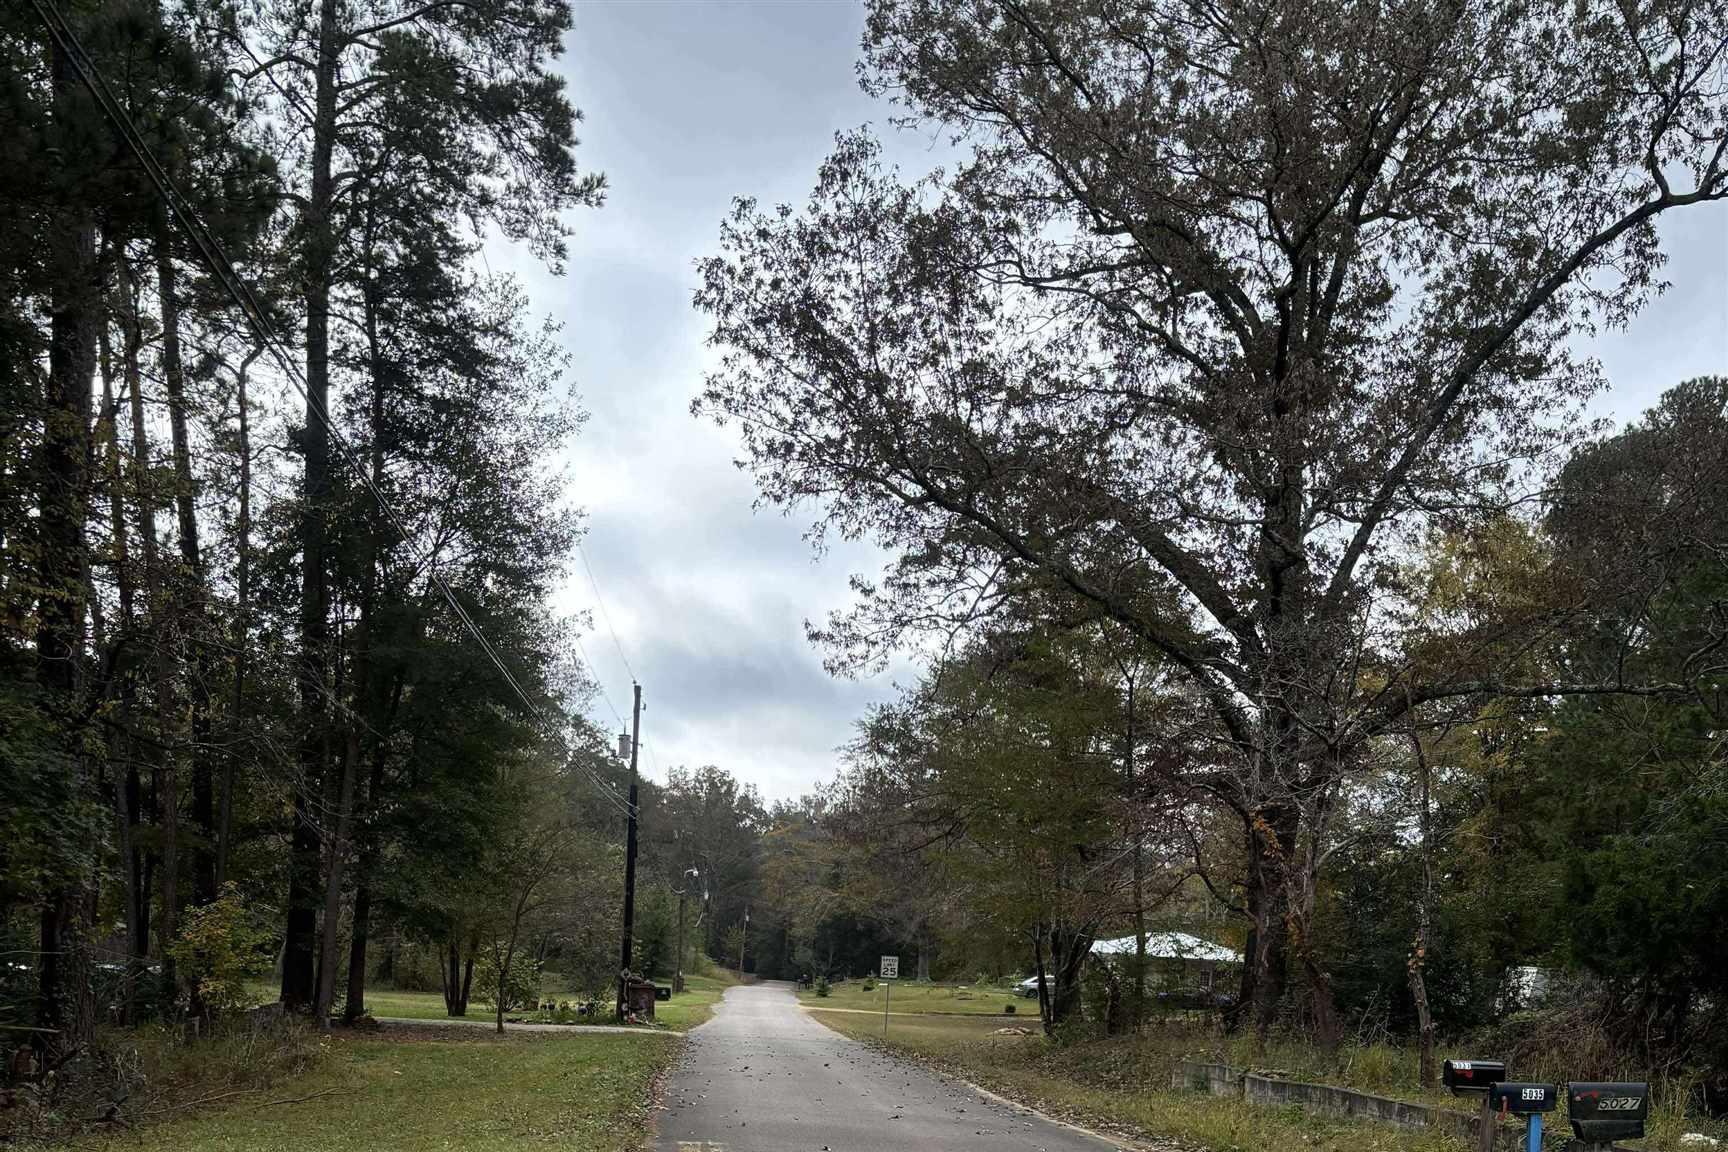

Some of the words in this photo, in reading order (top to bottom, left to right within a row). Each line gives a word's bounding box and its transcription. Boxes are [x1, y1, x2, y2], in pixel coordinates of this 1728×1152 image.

[883, 967, 896, 976] 25
[1523, 1089, 1543, 1099] 5035
[1599, 1098, 1640, 1109] 5027
